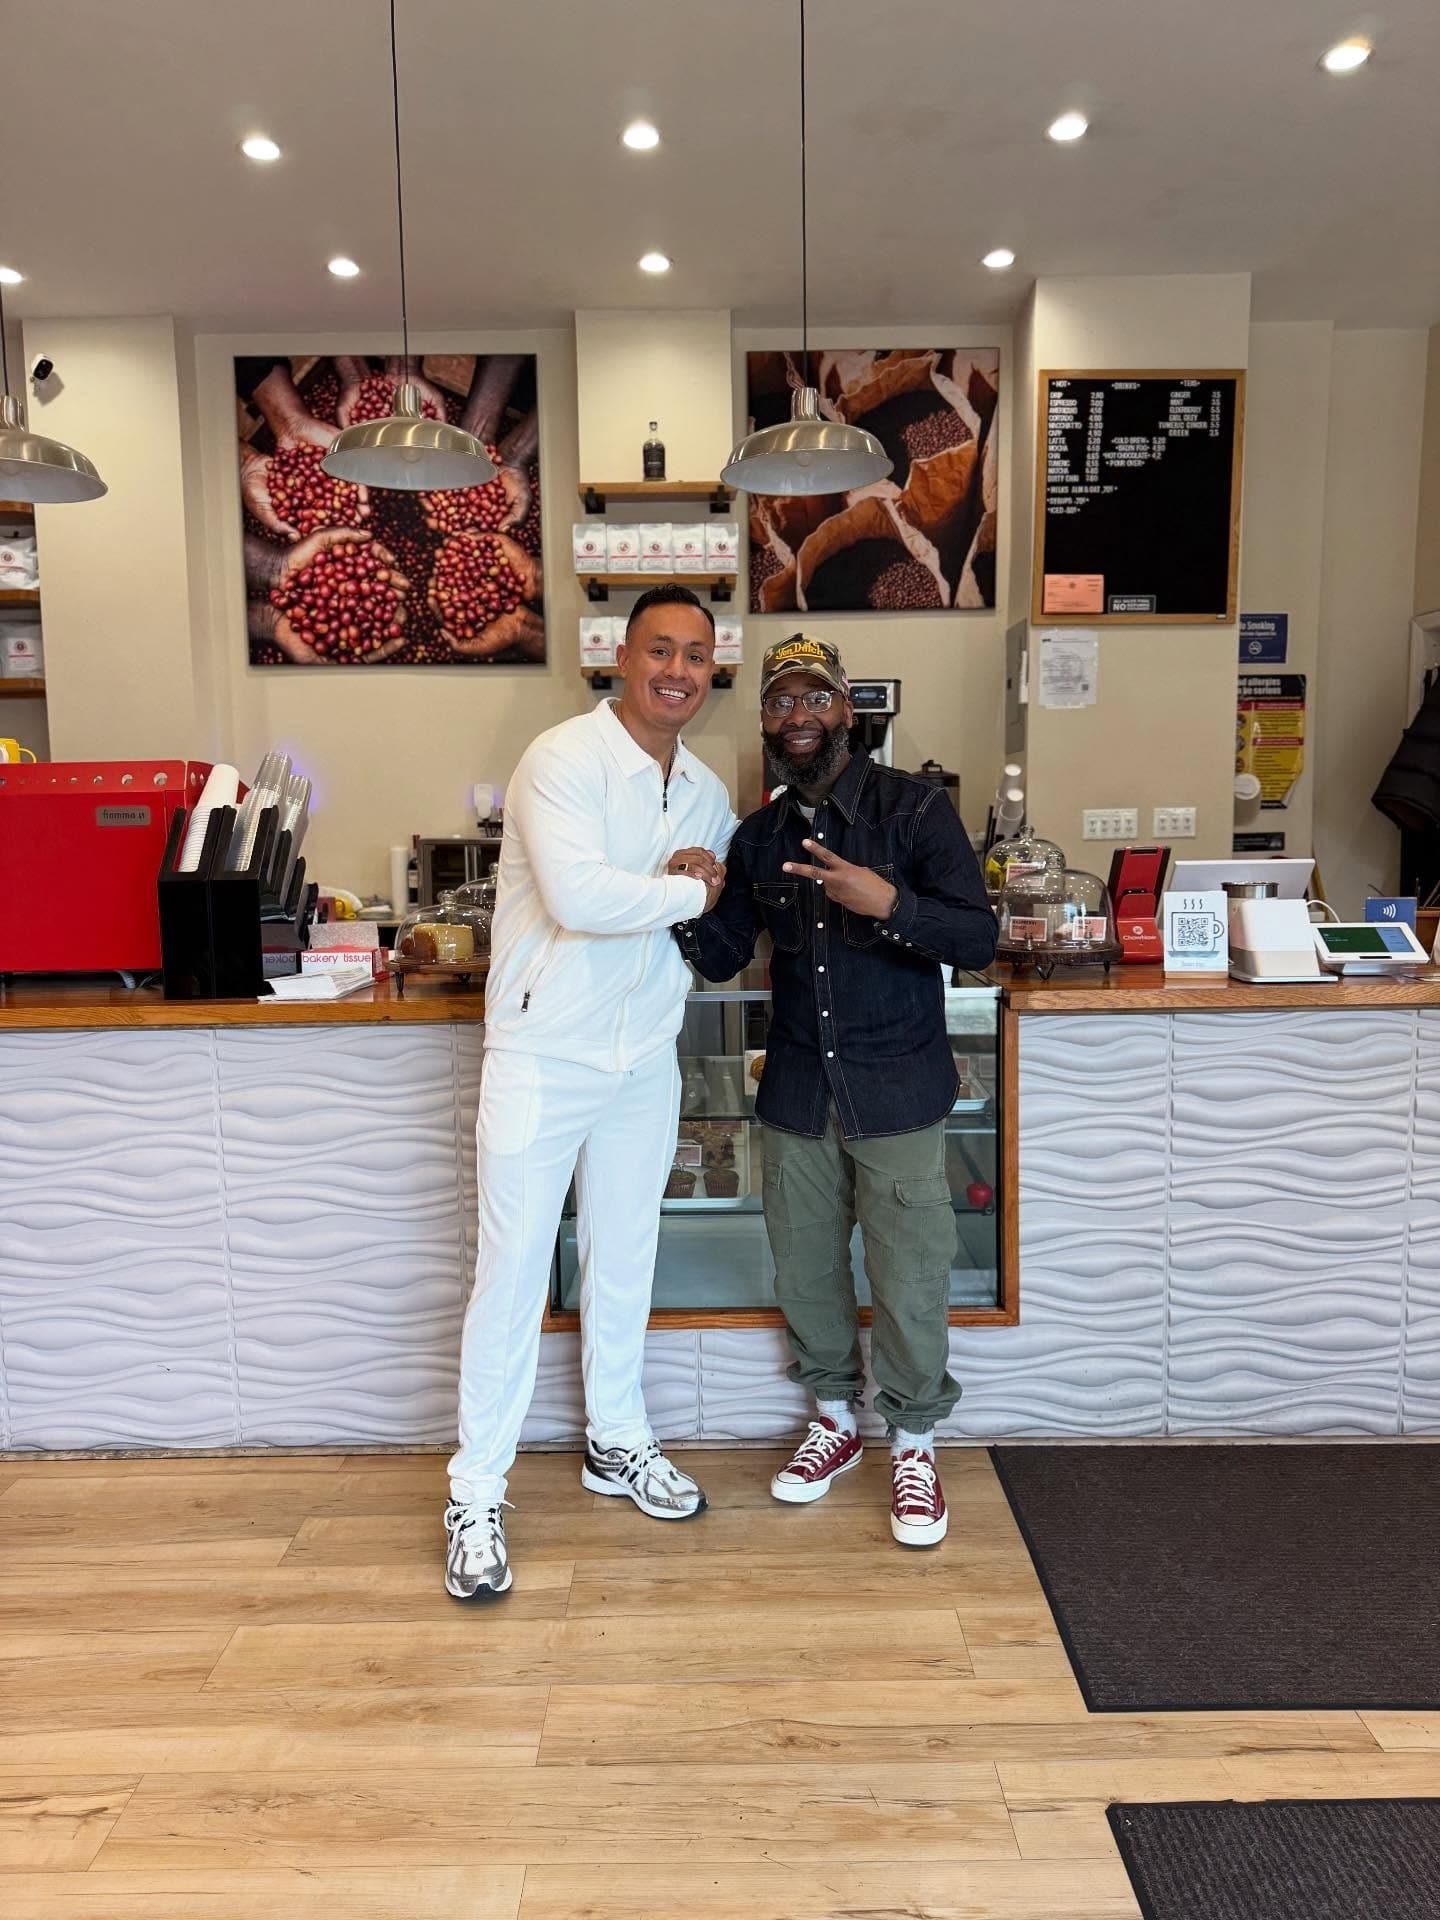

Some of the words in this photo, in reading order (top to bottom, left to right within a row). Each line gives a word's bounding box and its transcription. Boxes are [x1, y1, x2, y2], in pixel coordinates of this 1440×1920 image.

[1247, 621, 1275, 631] Smoking
[1248, 678, 1281, 687] allergies
[302, 954, 338, 965] bakery
[344, 953, 371, 963] tissue
